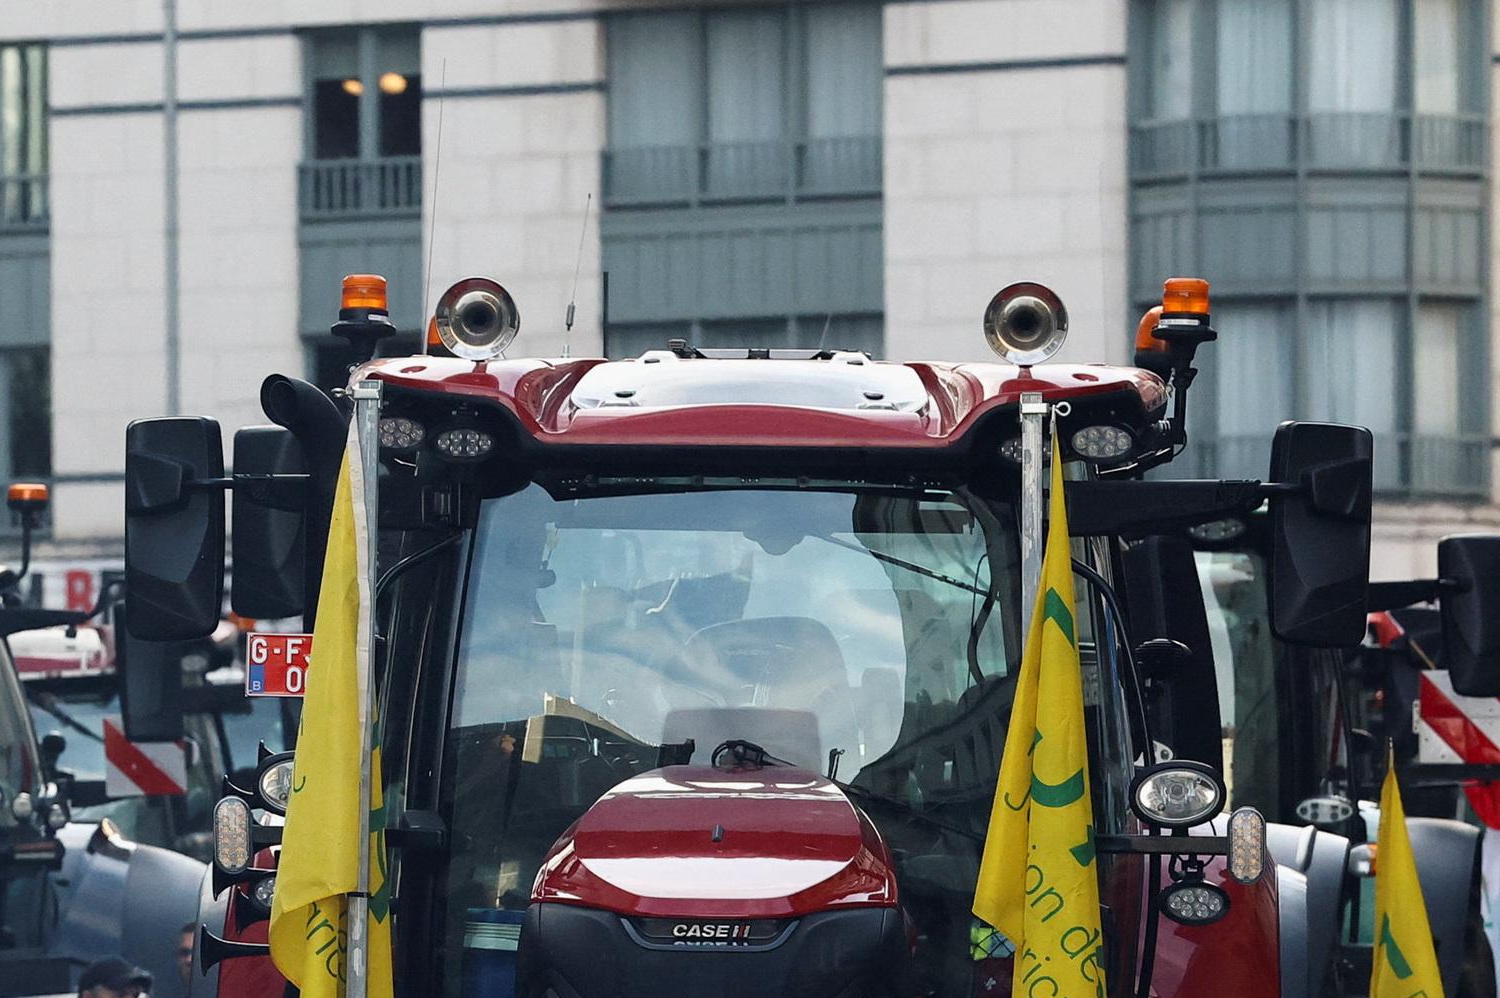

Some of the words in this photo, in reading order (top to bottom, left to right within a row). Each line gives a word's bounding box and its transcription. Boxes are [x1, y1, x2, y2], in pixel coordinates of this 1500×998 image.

[251, 637, 311, 665] G-F
[1024, 864, 1065, 923] on
[672, 924, 730, 938] CASE
